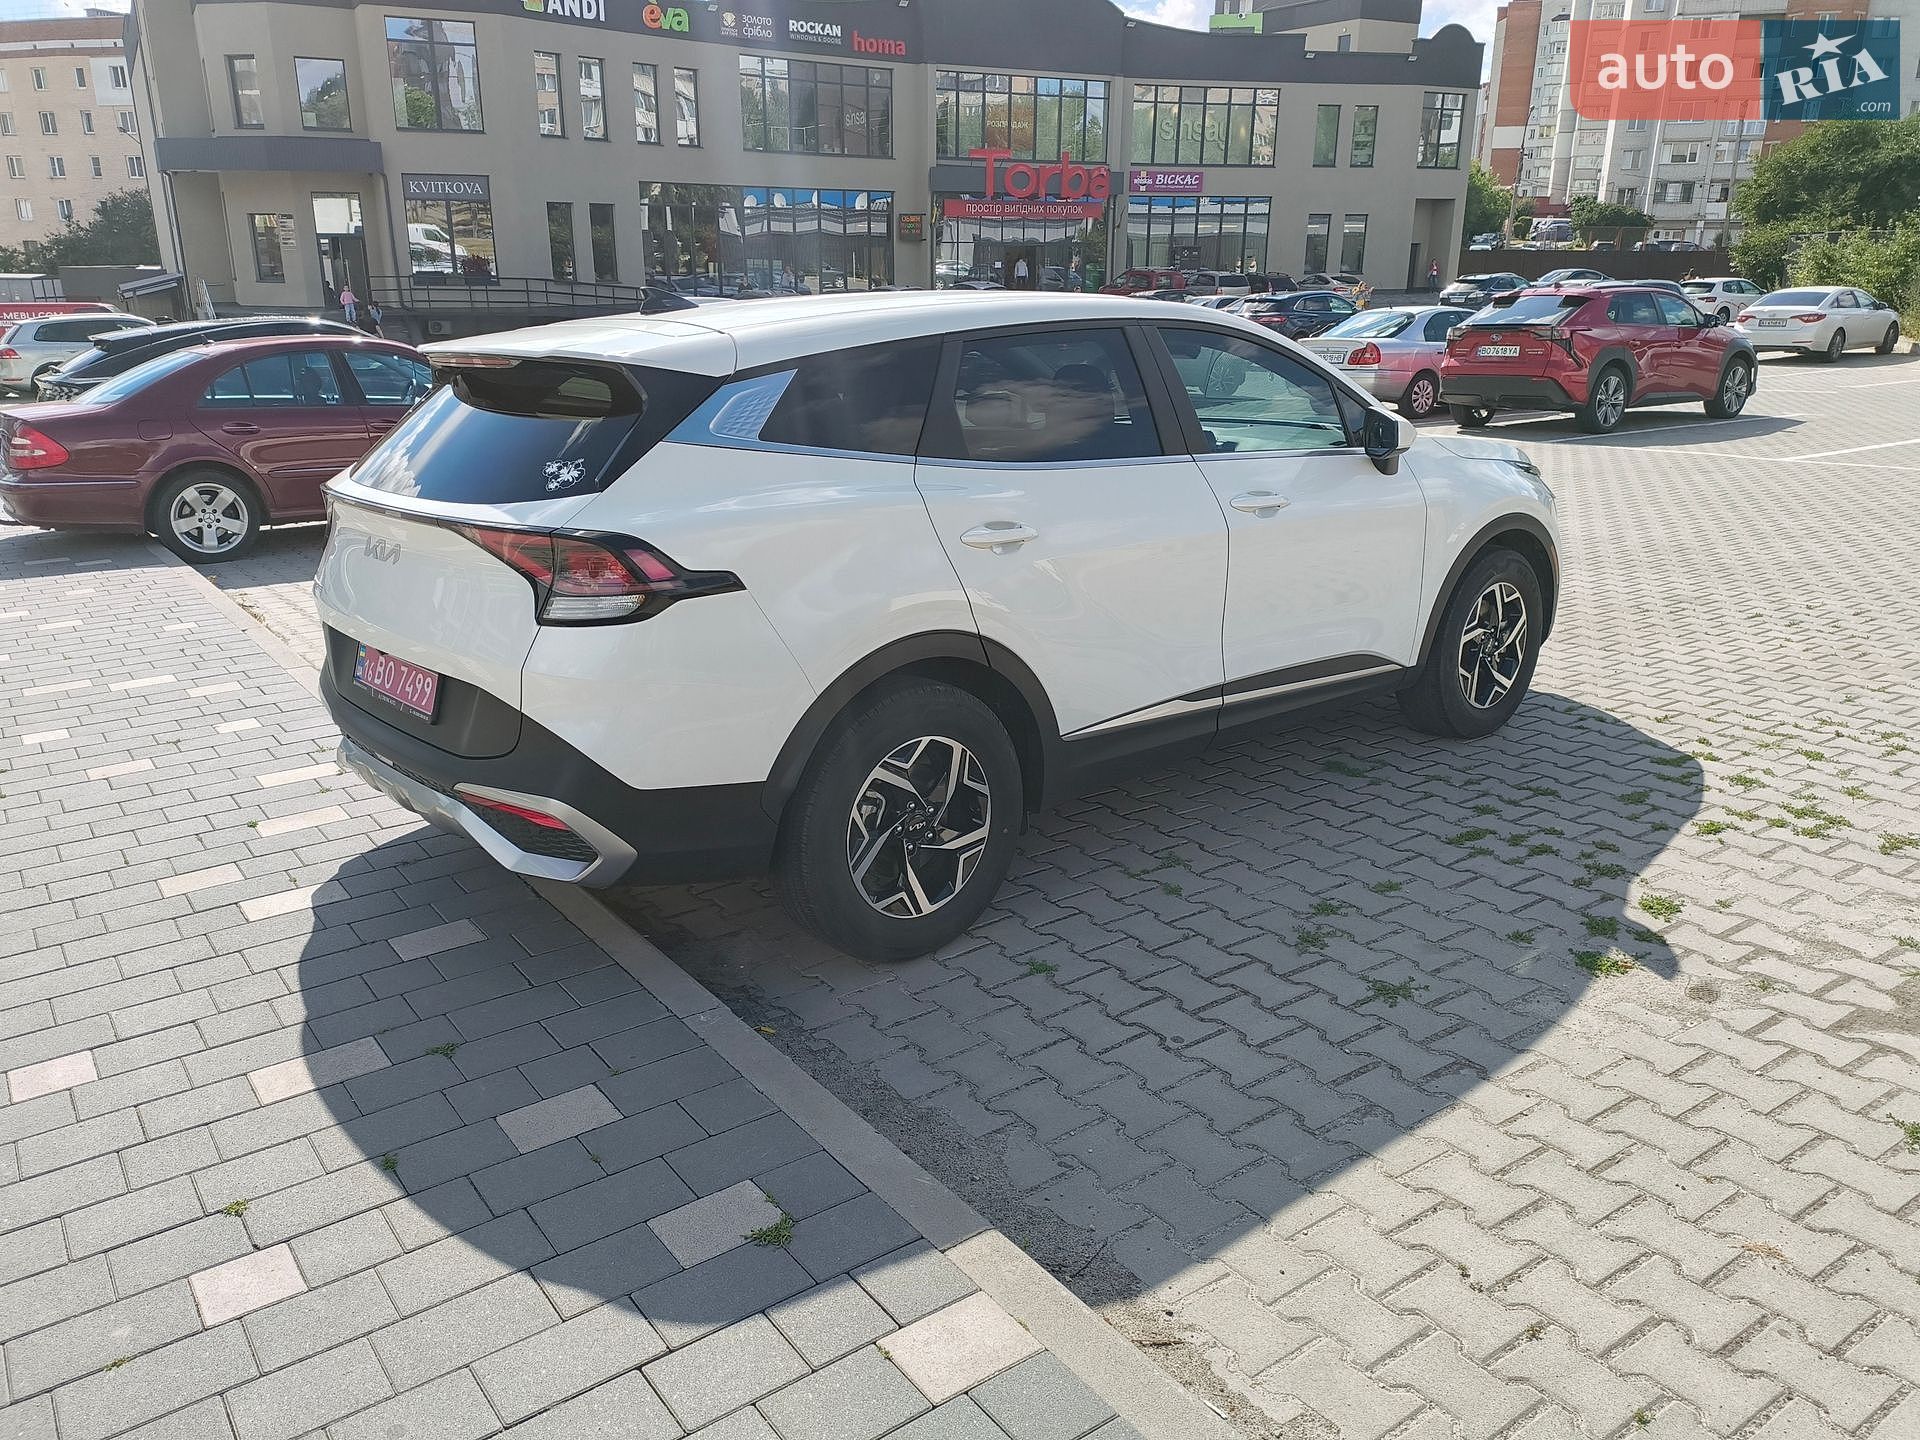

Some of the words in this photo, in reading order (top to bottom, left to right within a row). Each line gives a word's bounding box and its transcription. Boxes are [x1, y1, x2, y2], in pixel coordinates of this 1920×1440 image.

[789, 19, 842, 37] ROCKAN
[852, 31, 906, 56] homa
[1159, 118, 1231, 151] snsay
[968, 148, 1112, 200] Torba
[409, 181, 483, 194] KVITKOVA
[965, 202, 1003, 214] простір
[1004, 202, 1045, 215] вигідних
[1046, 203, 1083, 217] покупок
[396, 665, 433, 706] 7499
